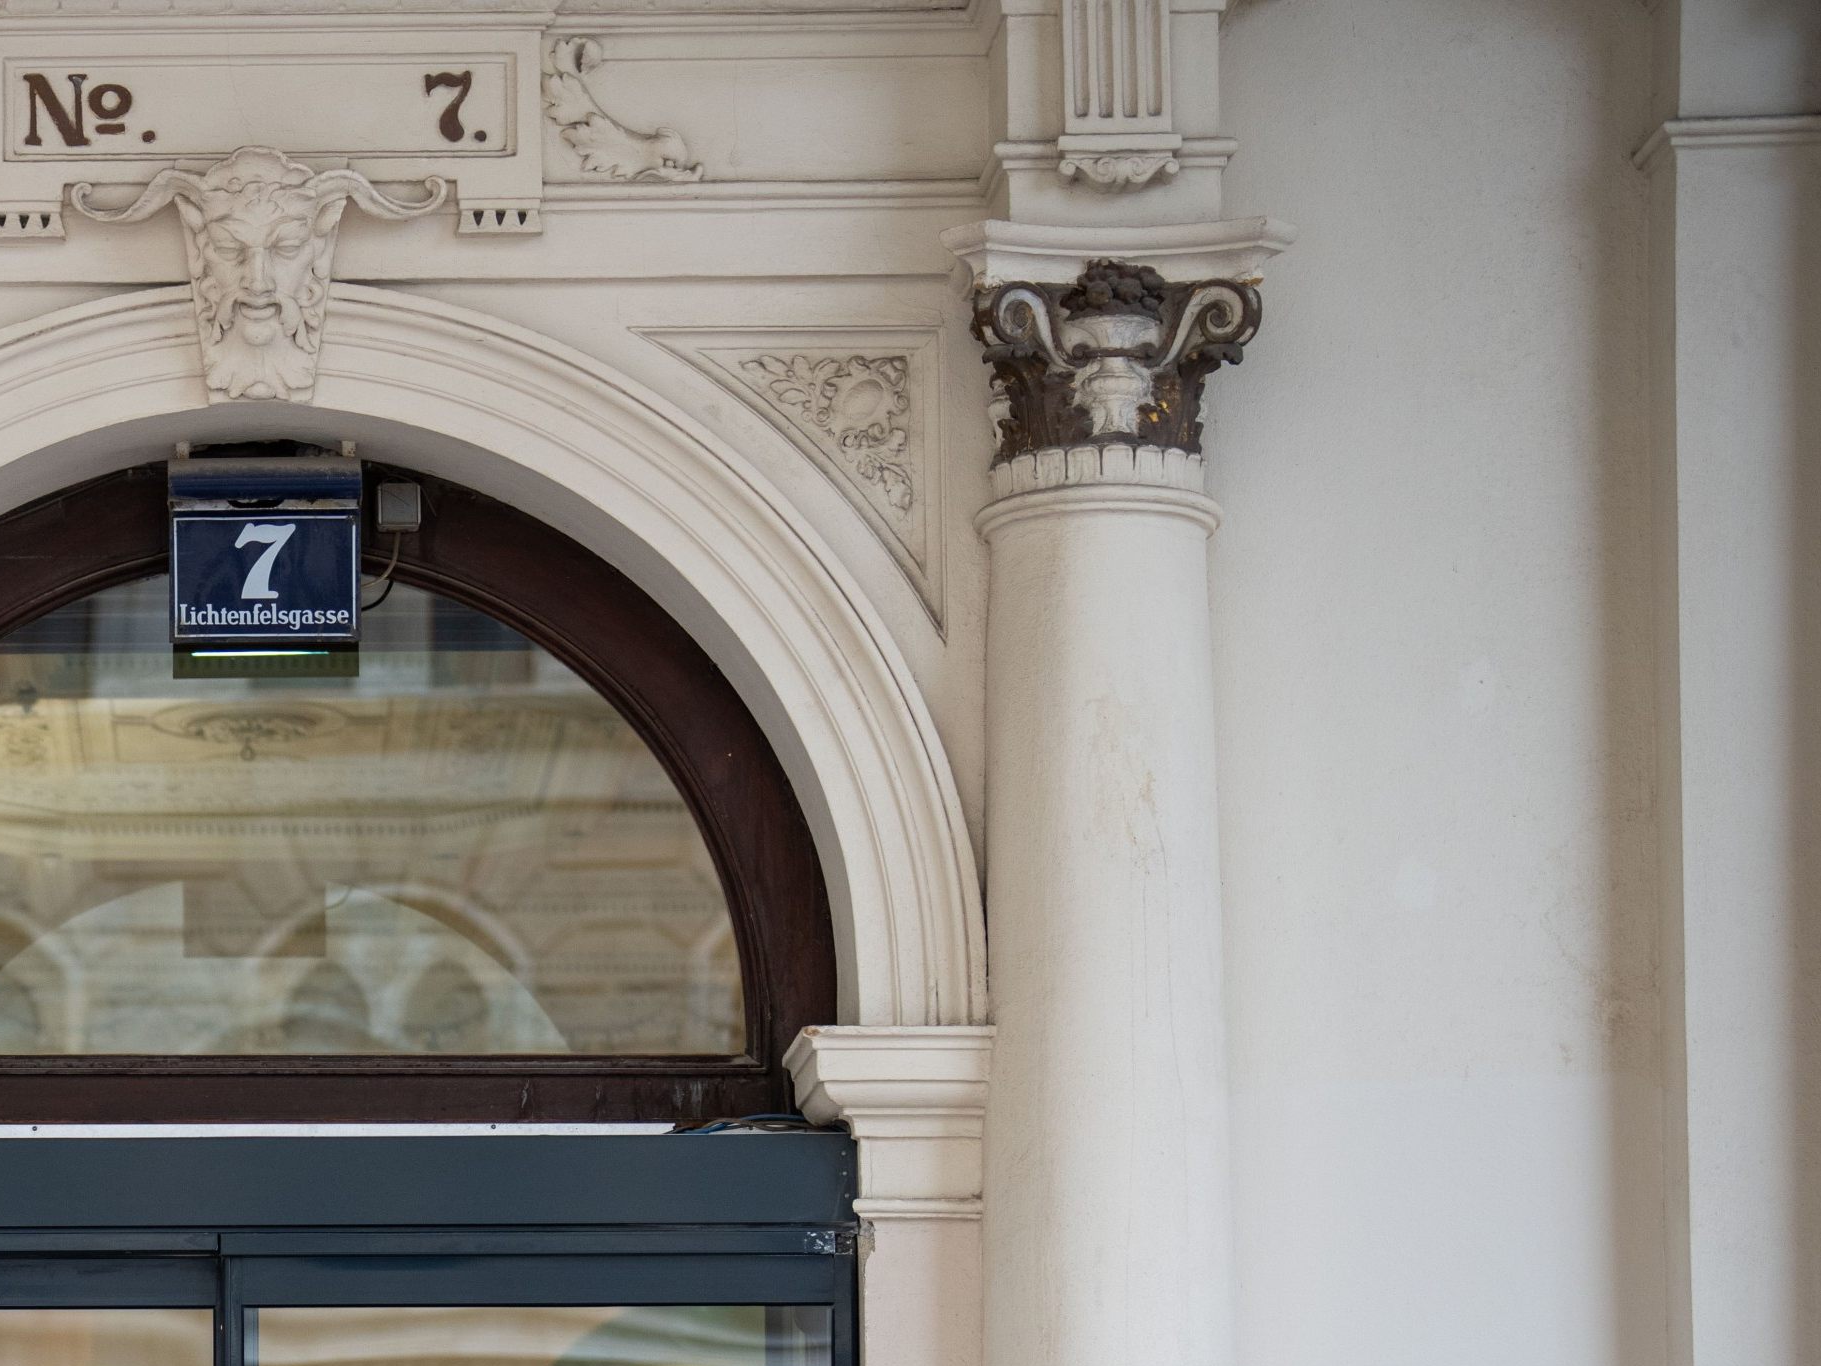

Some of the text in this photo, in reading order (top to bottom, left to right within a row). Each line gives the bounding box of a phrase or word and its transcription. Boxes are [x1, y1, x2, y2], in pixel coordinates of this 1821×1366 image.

[424, 70, 488, 143] 7.
[234, 522, 296, 600] 7
[179, 603, 350, 630] Lichtenfelsgasse
